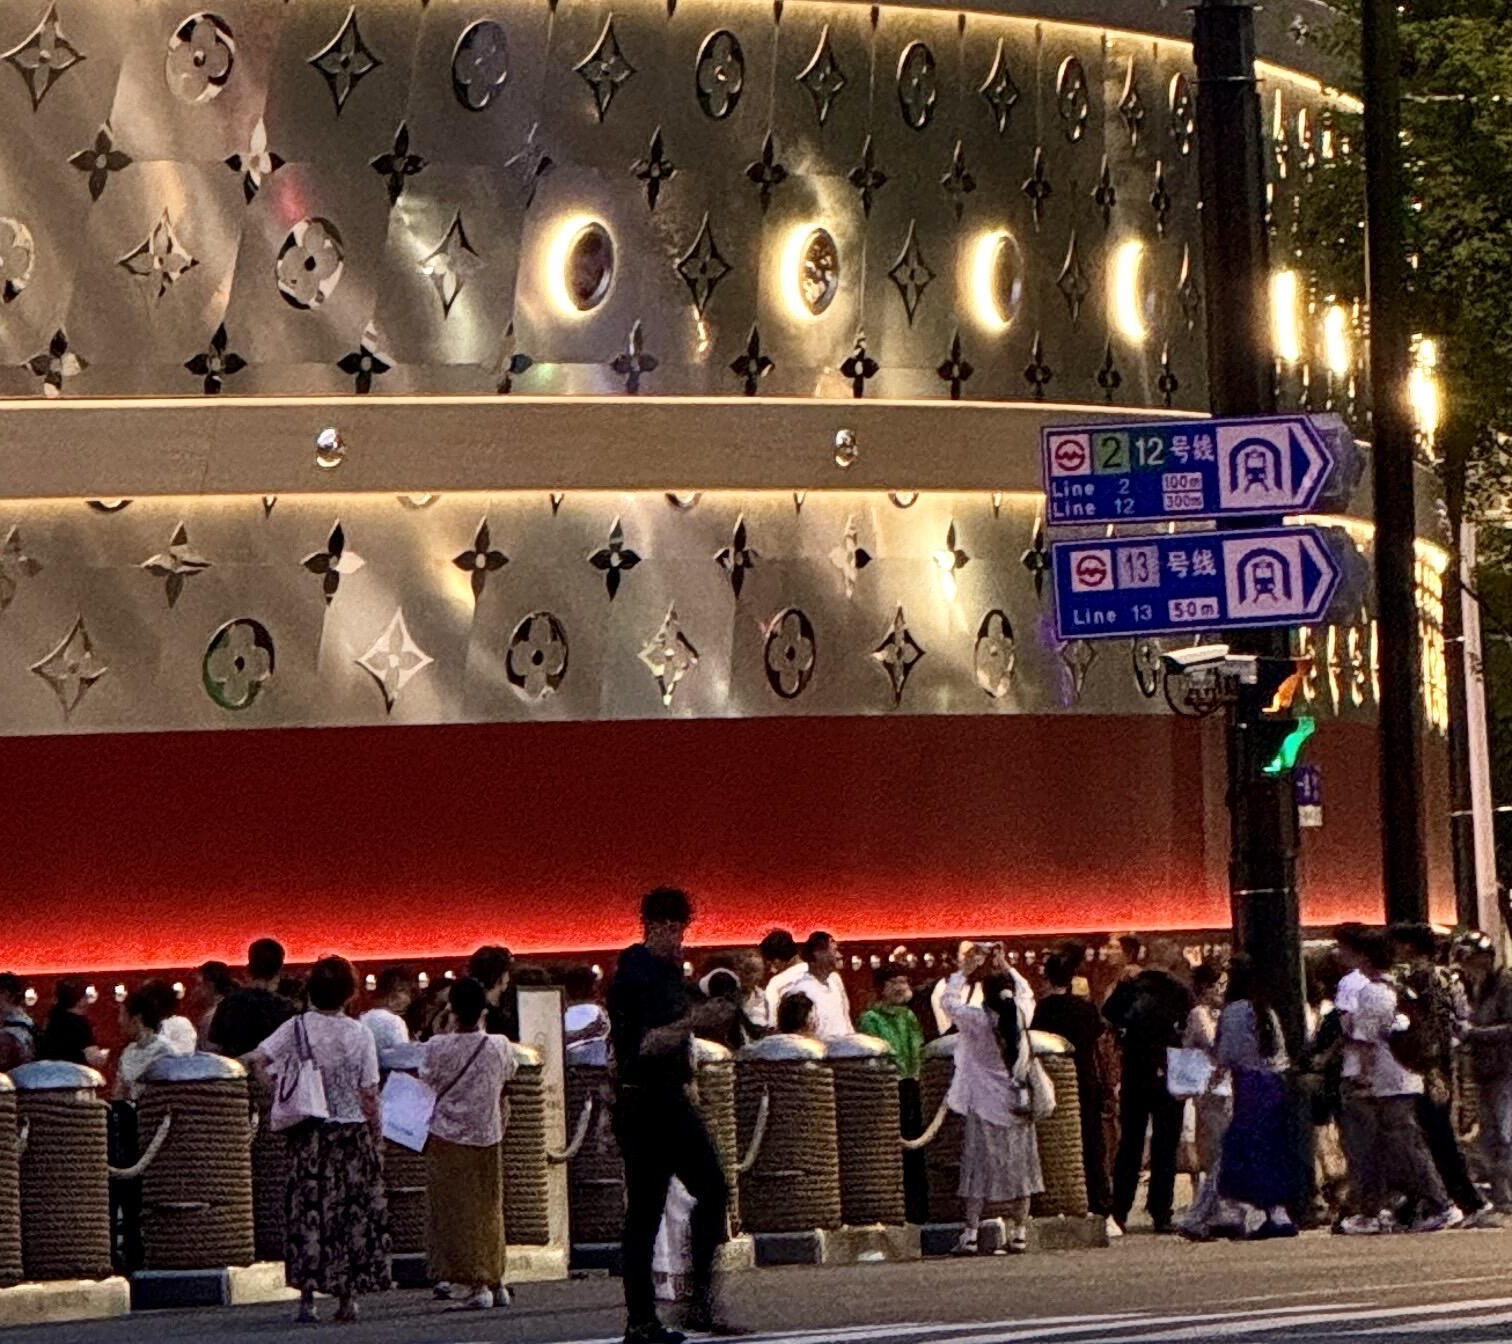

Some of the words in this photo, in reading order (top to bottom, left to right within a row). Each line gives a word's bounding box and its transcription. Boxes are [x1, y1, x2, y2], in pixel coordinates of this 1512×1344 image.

[1101, 436, 1122, 468] 2
[1135, 437, 1163, 466] 12
[1170, 434, 1215, 463] 号线
[1052, 480, 1095, 498] Line
[1117, 479, 1130, 494] 2
[1164, 475, 1202, 489] 100m
[1052, 500, 1096, 518] Line
[1114, 498, 1135, 514] 12
[1164, 494, 1204, 509] 300m
[1126, 551, 1150, 583] 13
[1167, 549, 1217, 578] 号线
[1073, 608, 1117, 626] Line
[1133, 605, 1152, 622] 13
[1173, 601, 1216, 618] 50m
